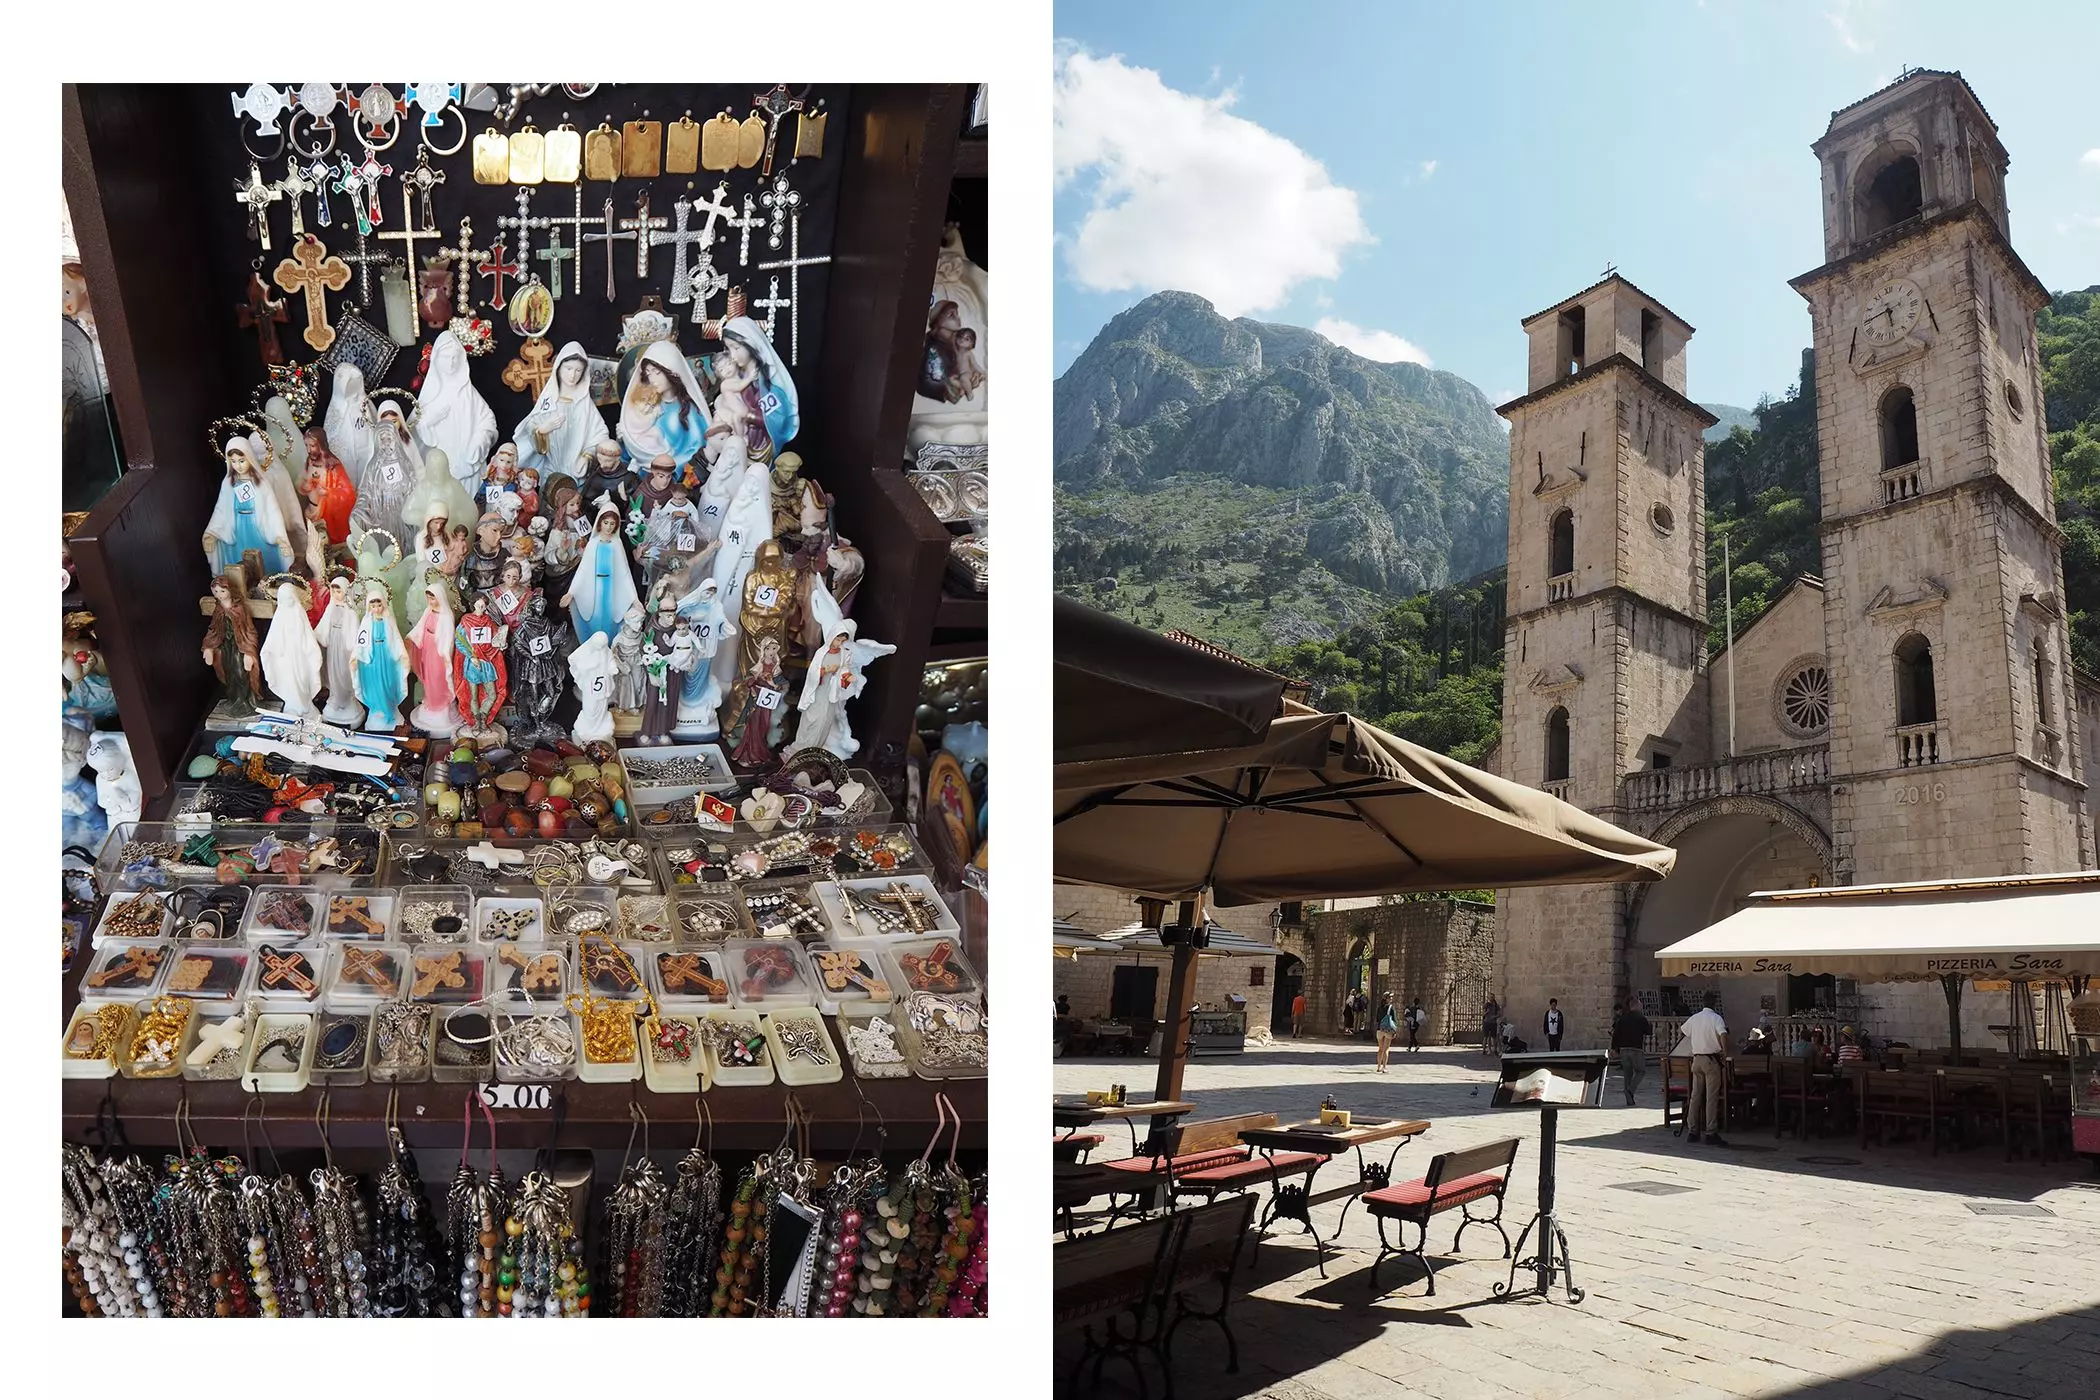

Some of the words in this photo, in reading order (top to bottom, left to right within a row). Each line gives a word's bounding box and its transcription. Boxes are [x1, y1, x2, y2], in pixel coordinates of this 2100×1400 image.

[760, 395, 778, 411] 20
[386, 466, 395, 481] 8
[241, 484, 251, 499] 8
[488, 488, 499, 500] 10
[703, 505, 718, 517] 12
[681, 537, 692, 548] 10
[431, 549, 440, 564] 8
[501, 593, 512, 609] 10
[759, 587, 774, 601] 5
[357, 629, 366, 644] 6
[474, 627, 485, 641] 7
[694, 623, 710, 638] 10
[535, 638, 544, 652] 5
[592, 676, 603, 692] 5
[761, 691, 774, 707] 5
[1895, 782, 1947, 805] 2016
[601, 863, 610, 873] 17
[1690, 962, 1743, 972] PIZZERIA
[1752, 958, 1793, 973] Sara
[1927, 958, 1997, 970] PIZZERIA
[2009, 954, 2064, 970] Sara
[482, 1085, 551, 1109] 5.00
